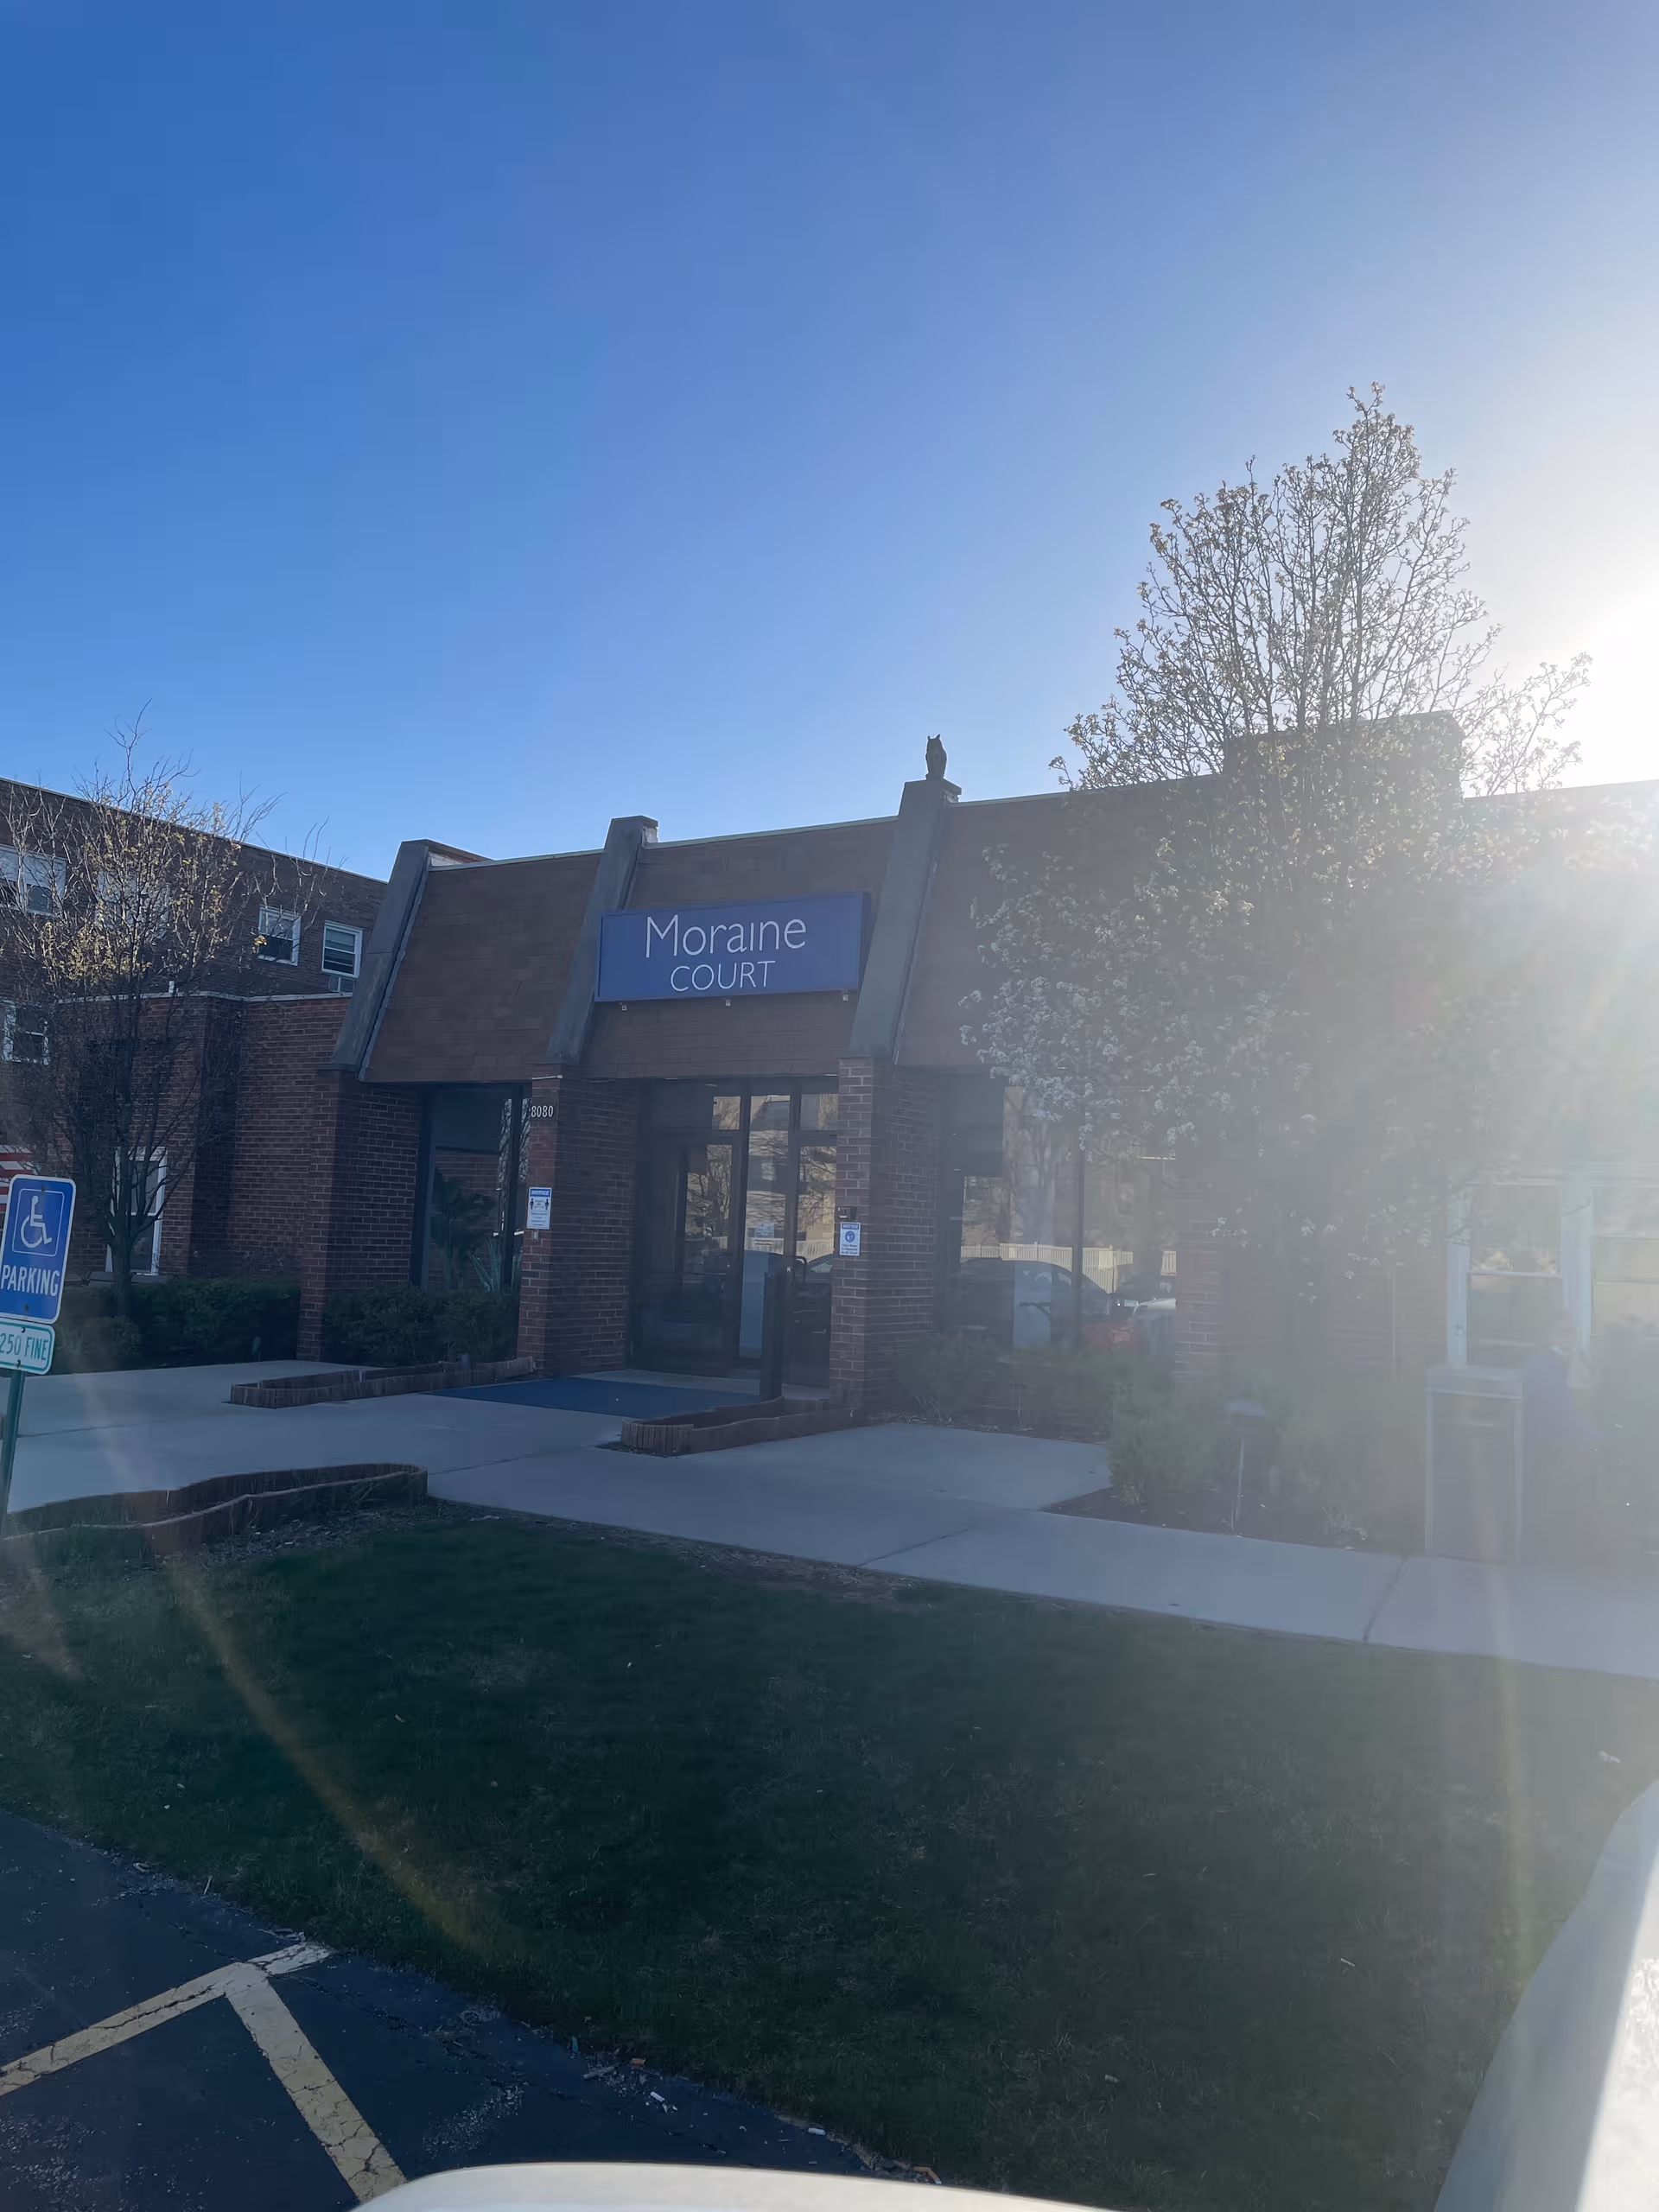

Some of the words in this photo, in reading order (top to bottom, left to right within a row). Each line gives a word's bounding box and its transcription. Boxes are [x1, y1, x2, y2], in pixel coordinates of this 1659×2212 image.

[645, 914, 806, 957] Moraine
[671, 960, 776, 992] COURT
[531, 1105, 554, 1118] 8080
[0, 1264, 60, 1297] PARKING
[24, 1337, 48, 1361] FINE
